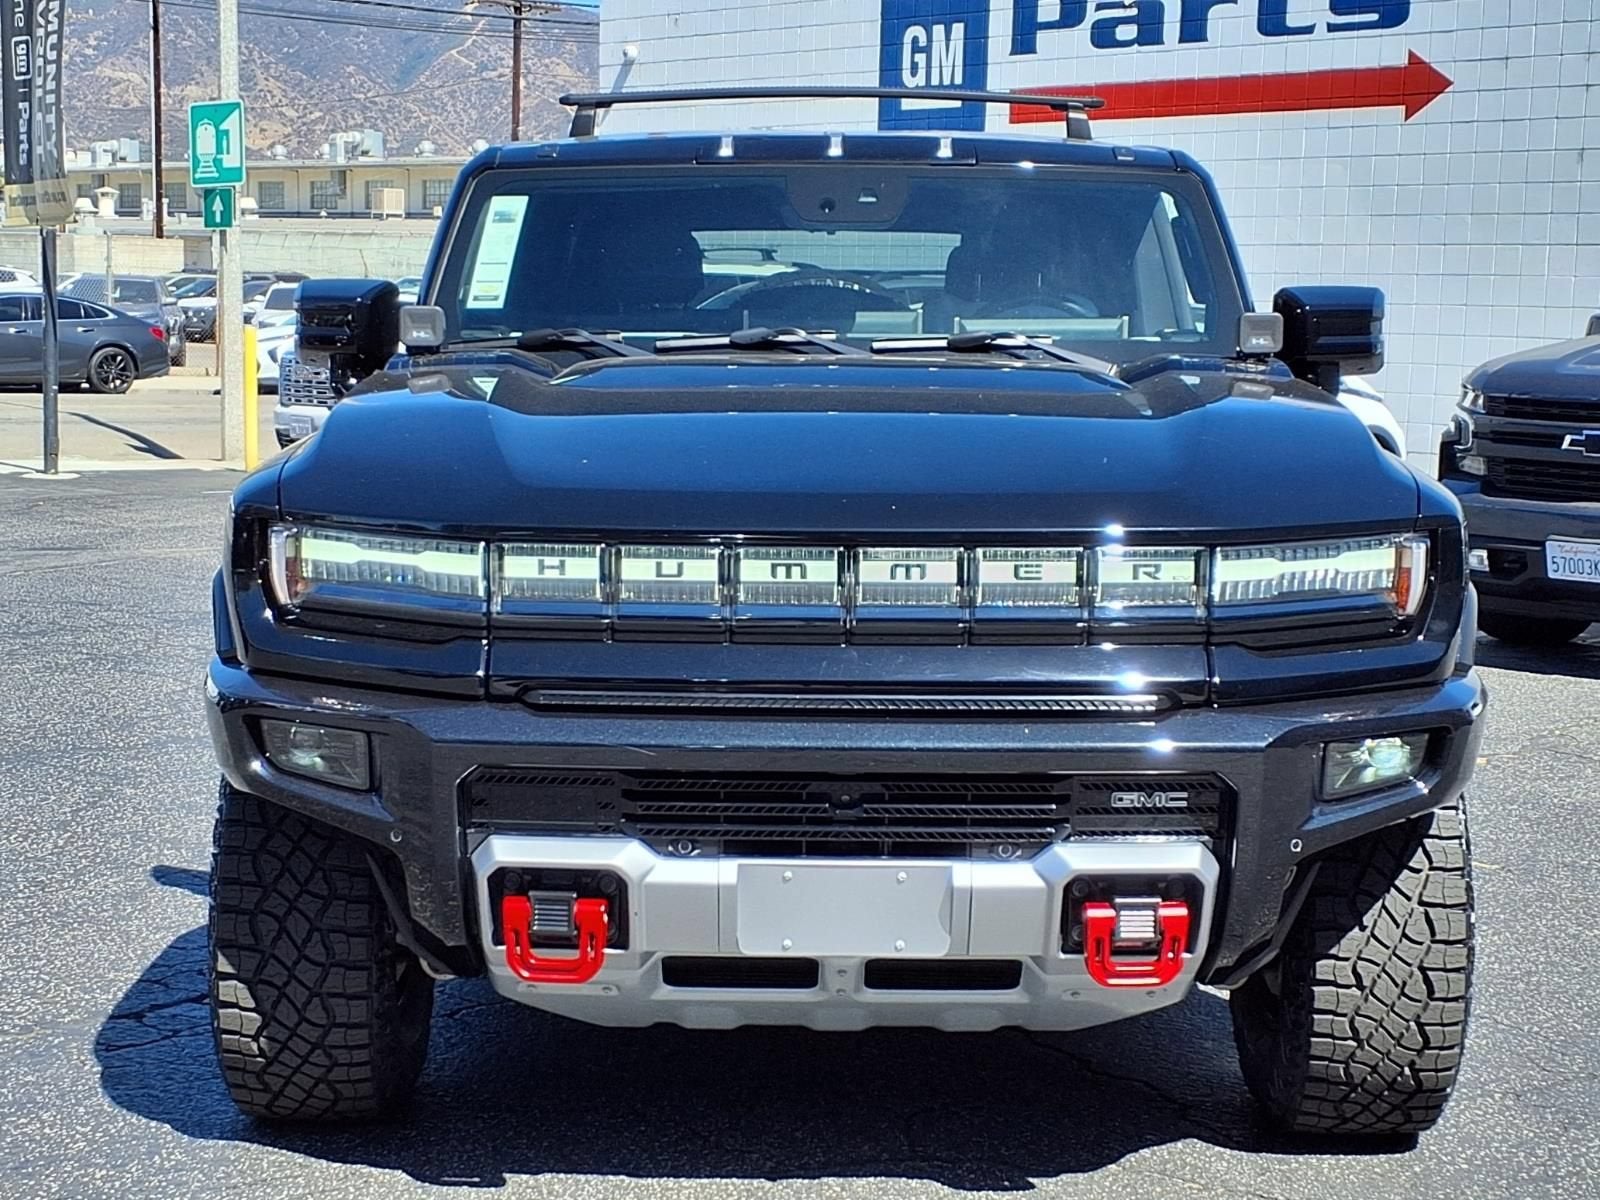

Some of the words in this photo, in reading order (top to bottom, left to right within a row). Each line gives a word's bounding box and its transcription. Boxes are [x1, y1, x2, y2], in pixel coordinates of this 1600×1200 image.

[901, 22, 966, 89] GM
[18, 101, 30, 166] Parts
[537, 558, 1162, 581] HUMMER
[1110, 791, 1189, 808] GMC
